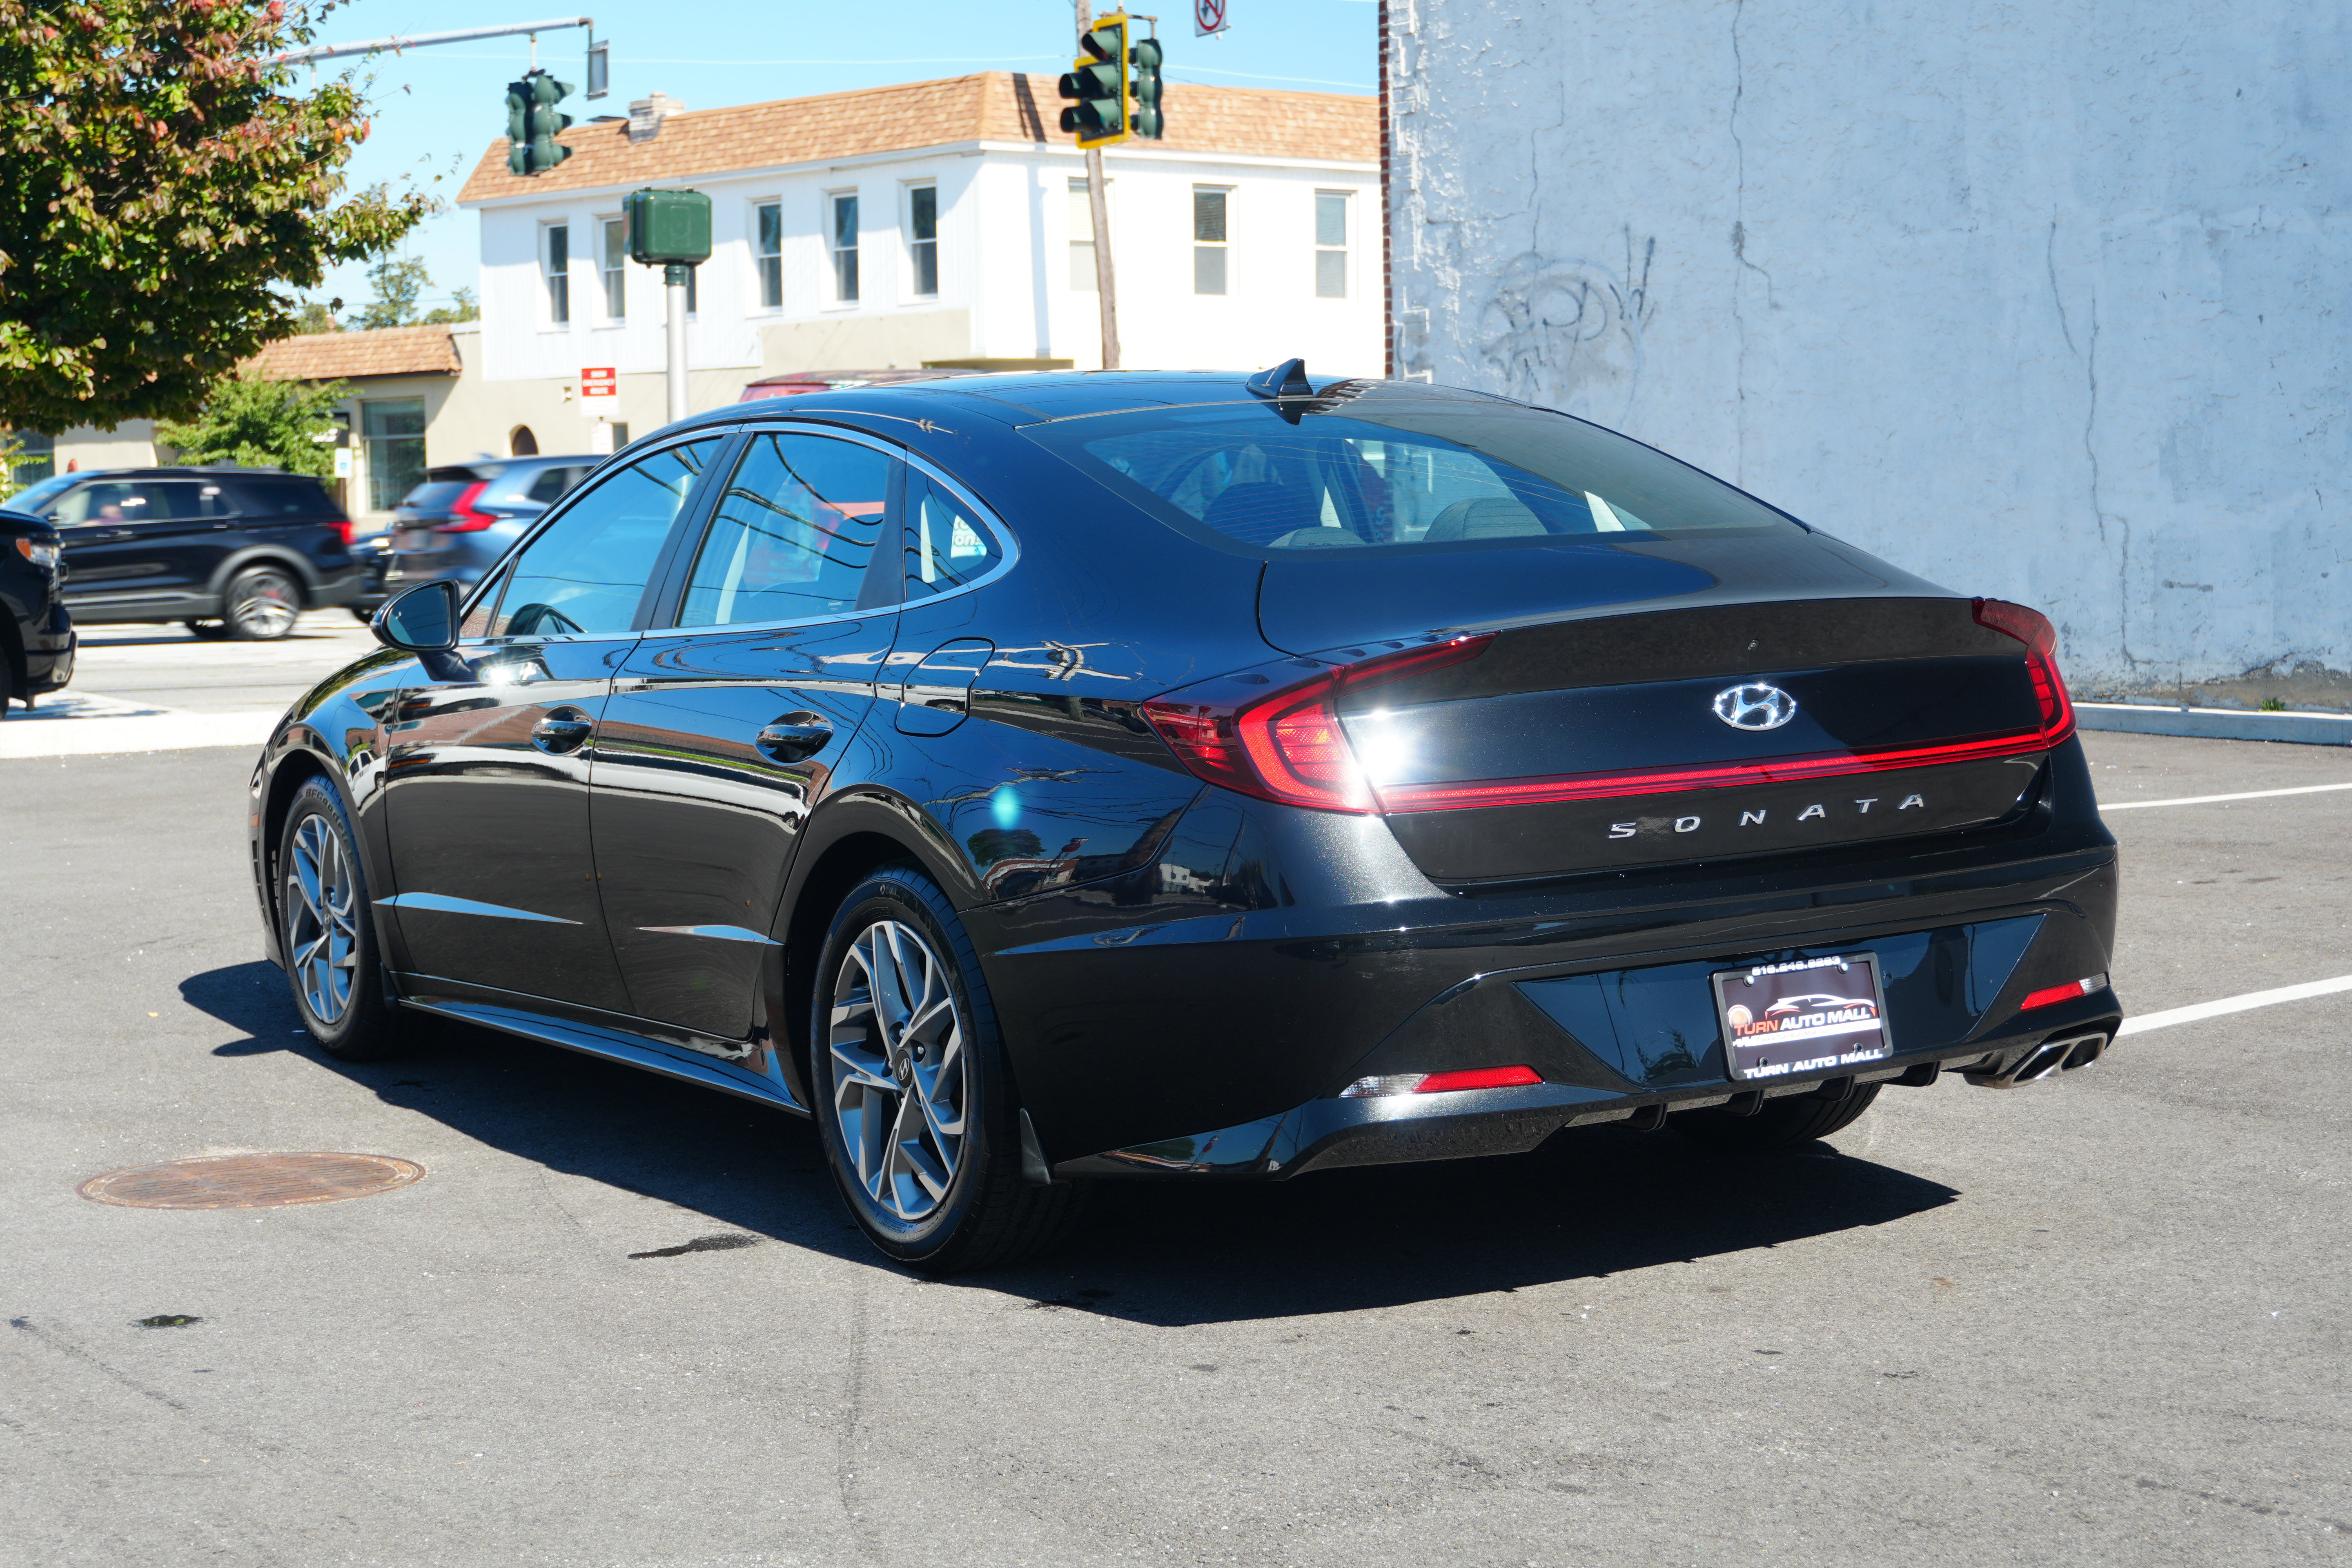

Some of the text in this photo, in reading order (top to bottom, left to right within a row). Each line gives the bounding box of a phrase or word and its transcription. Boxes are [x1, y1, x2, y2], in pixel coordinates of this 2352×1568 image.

[1606, 794, 1925, 839] SONATA
[1734, 1007, 1870, 1036] TURN AUTO MALL
[1744, 1049, 1883, 1079] TURN AUTO MALL
